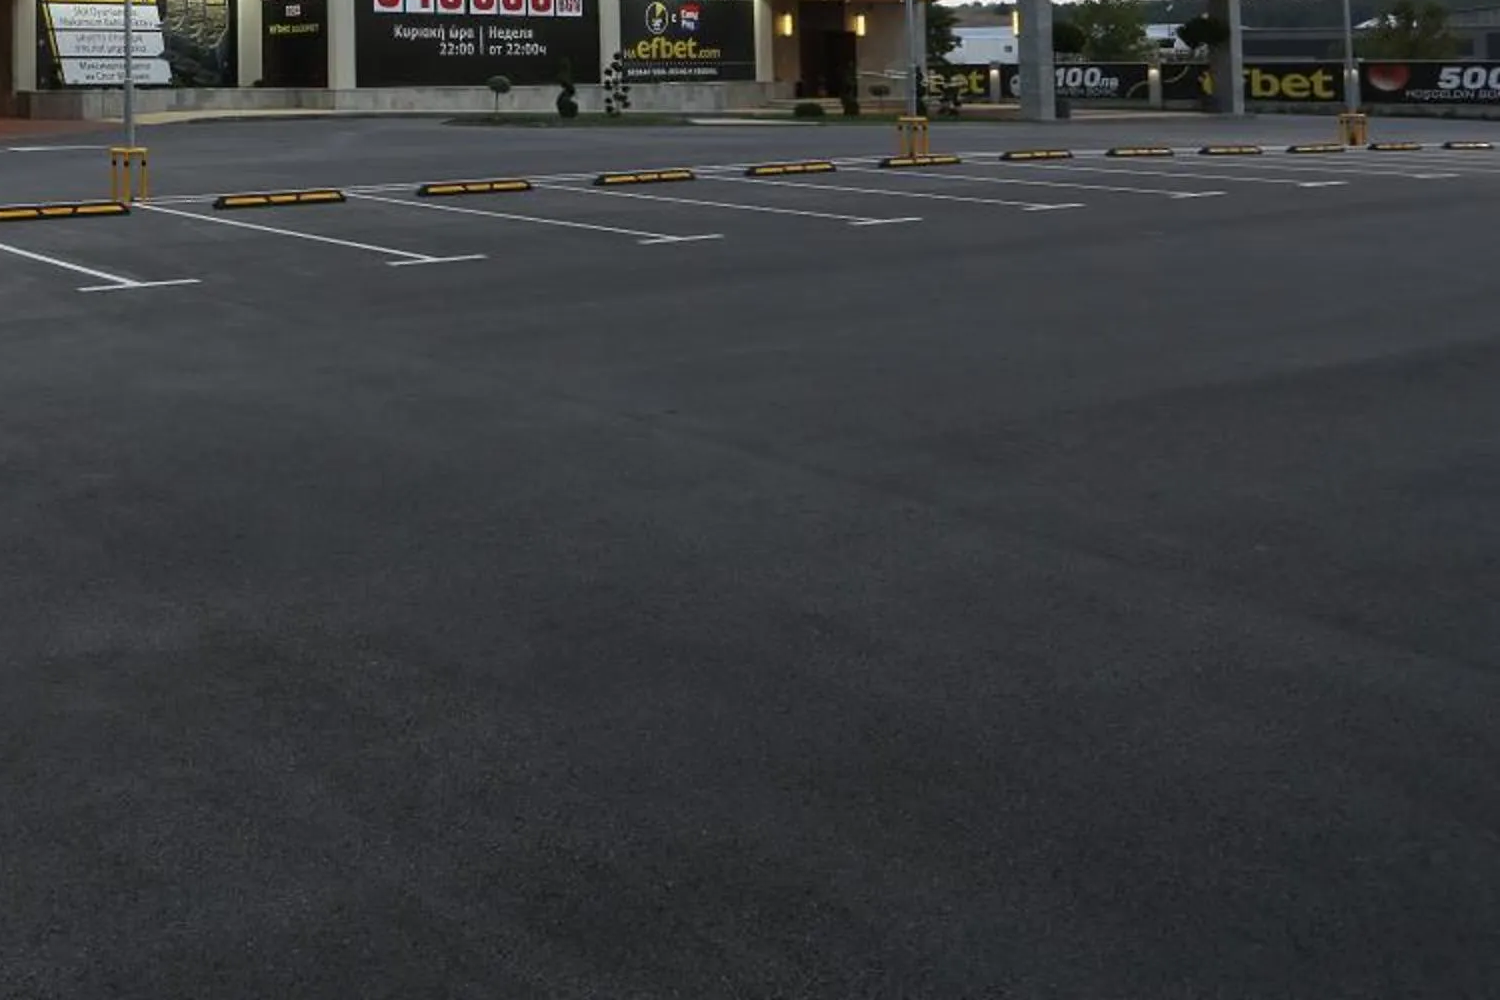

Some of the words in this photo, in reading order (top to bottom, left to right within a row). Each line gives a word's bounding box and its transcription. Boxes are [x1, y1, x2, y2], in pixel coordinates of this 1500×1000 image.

[489, 25, 533, 41] Неделя
[440, 42, 475, 56] 22:00
[489, 44, 503, 56] от
